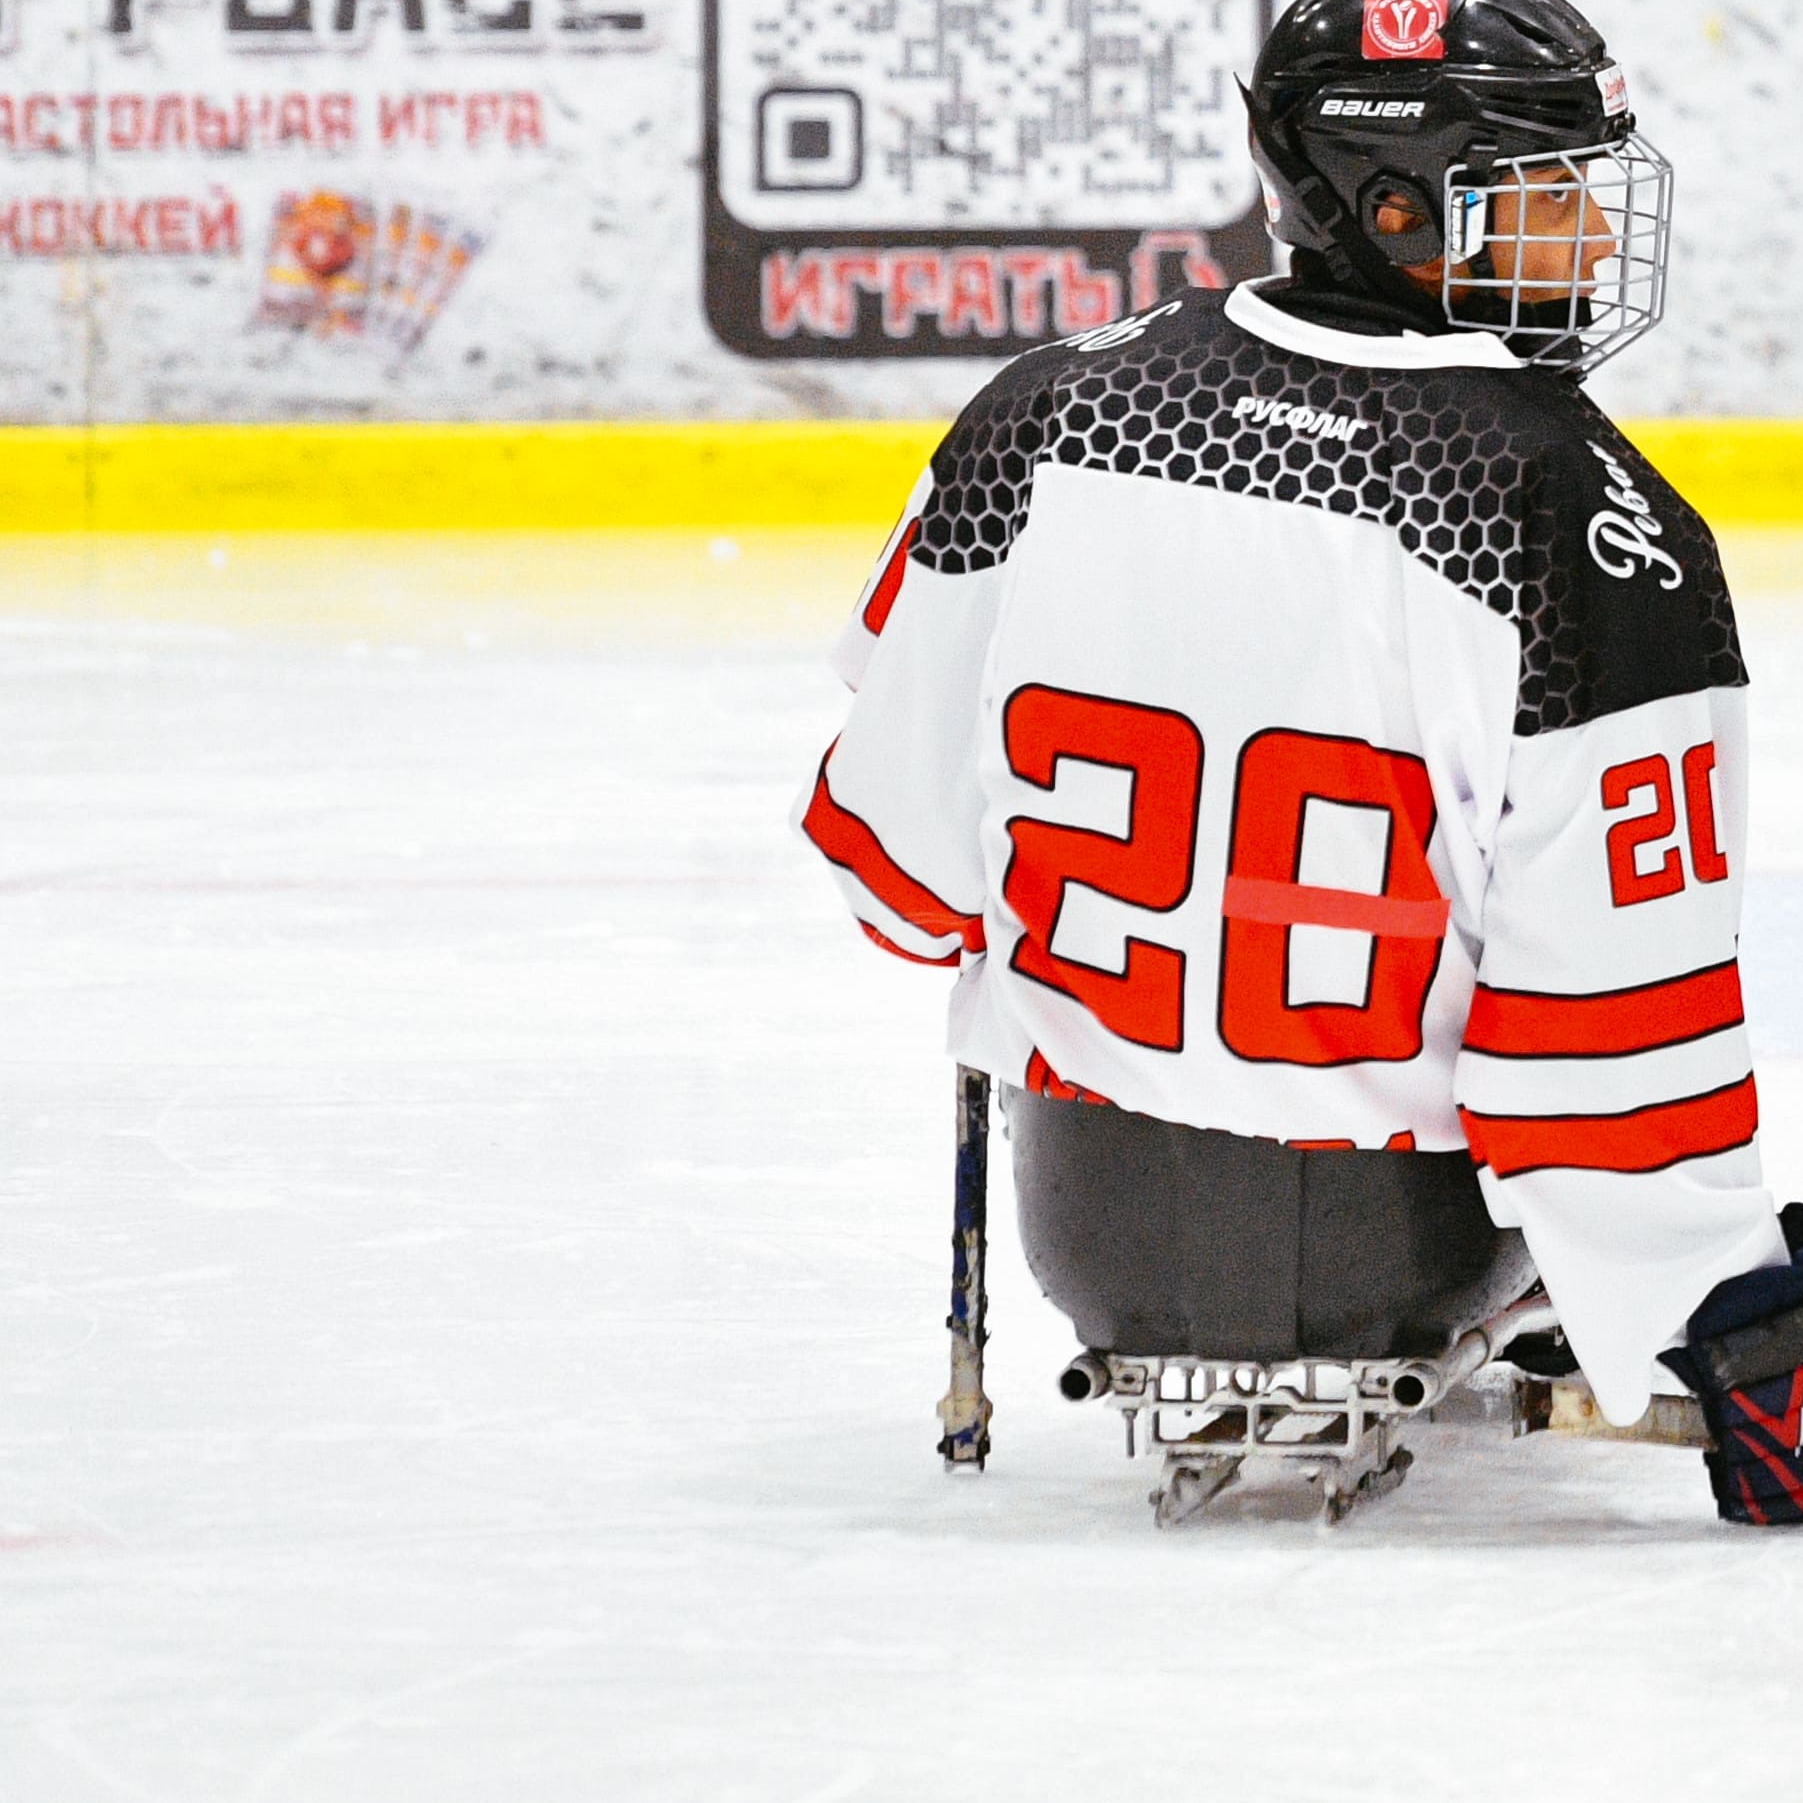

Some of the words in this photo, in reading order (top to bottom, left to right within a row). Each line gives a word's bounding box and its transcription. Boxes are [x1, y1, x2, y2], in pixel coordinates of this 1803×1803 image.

[377, 91, 548, 149] ИГРА
[1319, 99, 1426, 118] BAUER
[760, 247, 1119, 339] ИГРАТЬ
[1231, 396, 1369, 443] РУСФЛАГ
